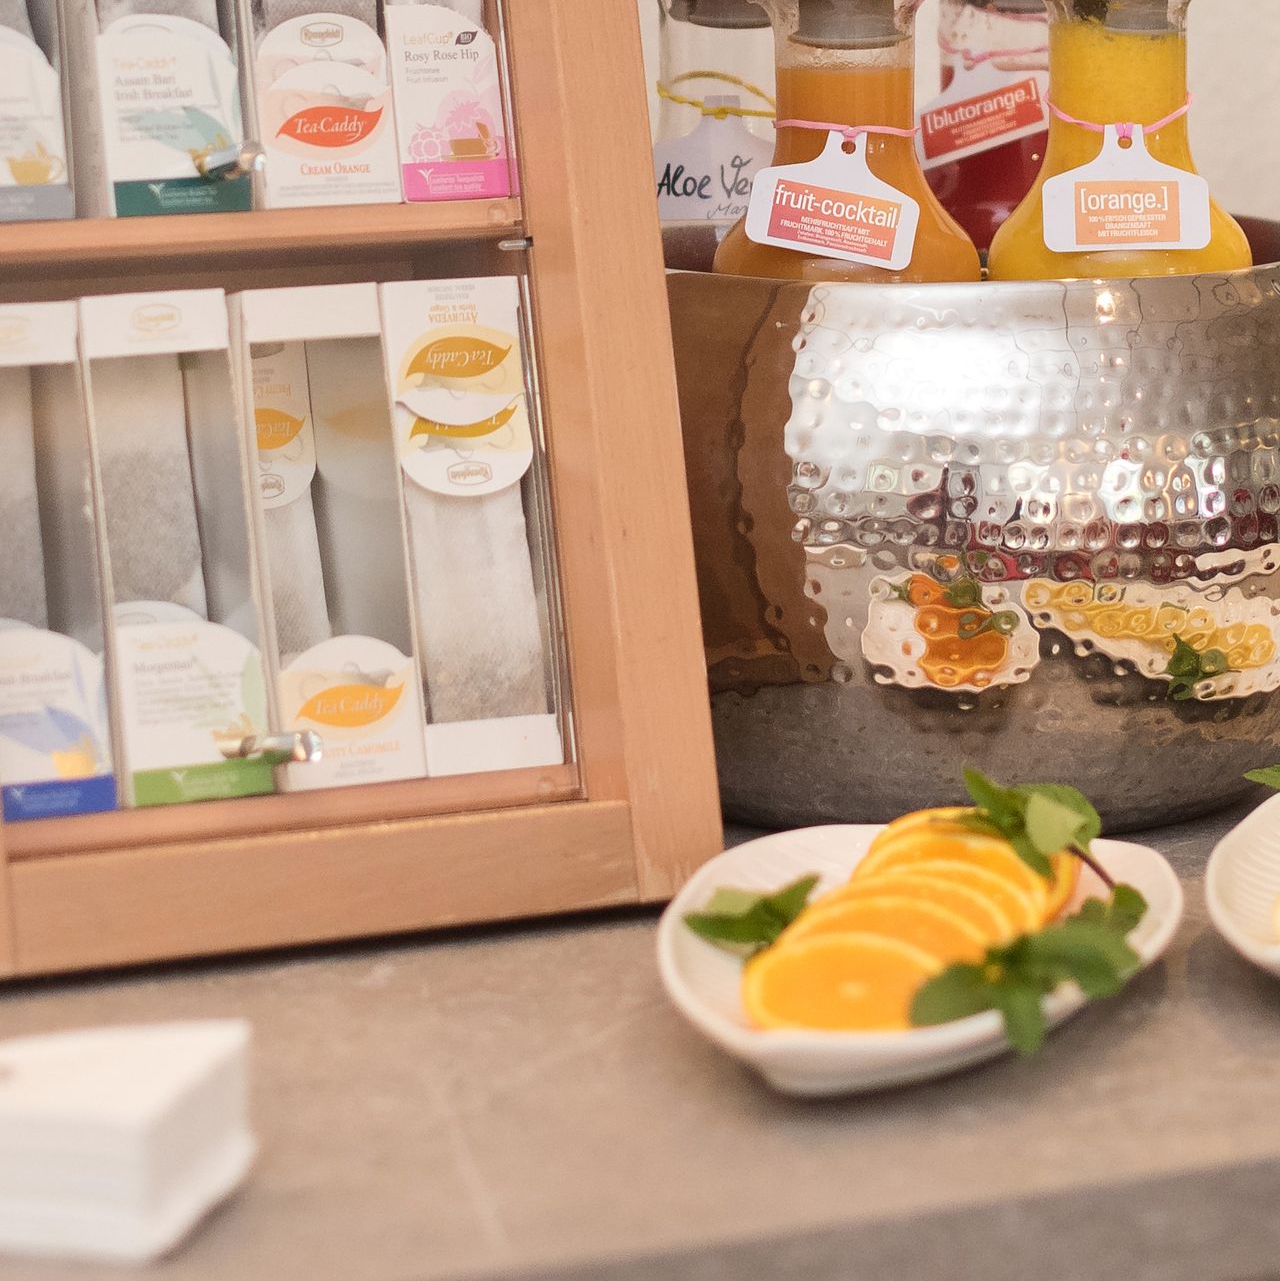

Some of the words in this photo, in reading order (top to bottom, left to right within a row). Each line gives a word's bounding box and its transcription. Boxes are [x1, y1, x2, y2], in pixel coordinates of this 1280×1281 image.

[404, 50, 430, 64] Rosy
[433, 49, 458, 61] Rose
[461, 48, 480, 62] Hip
[657, 163, 712, 200] Aloe
[1080, 186, 1169, 214] [orange.]
[427, 311, 479, 324] AYURVEDA
